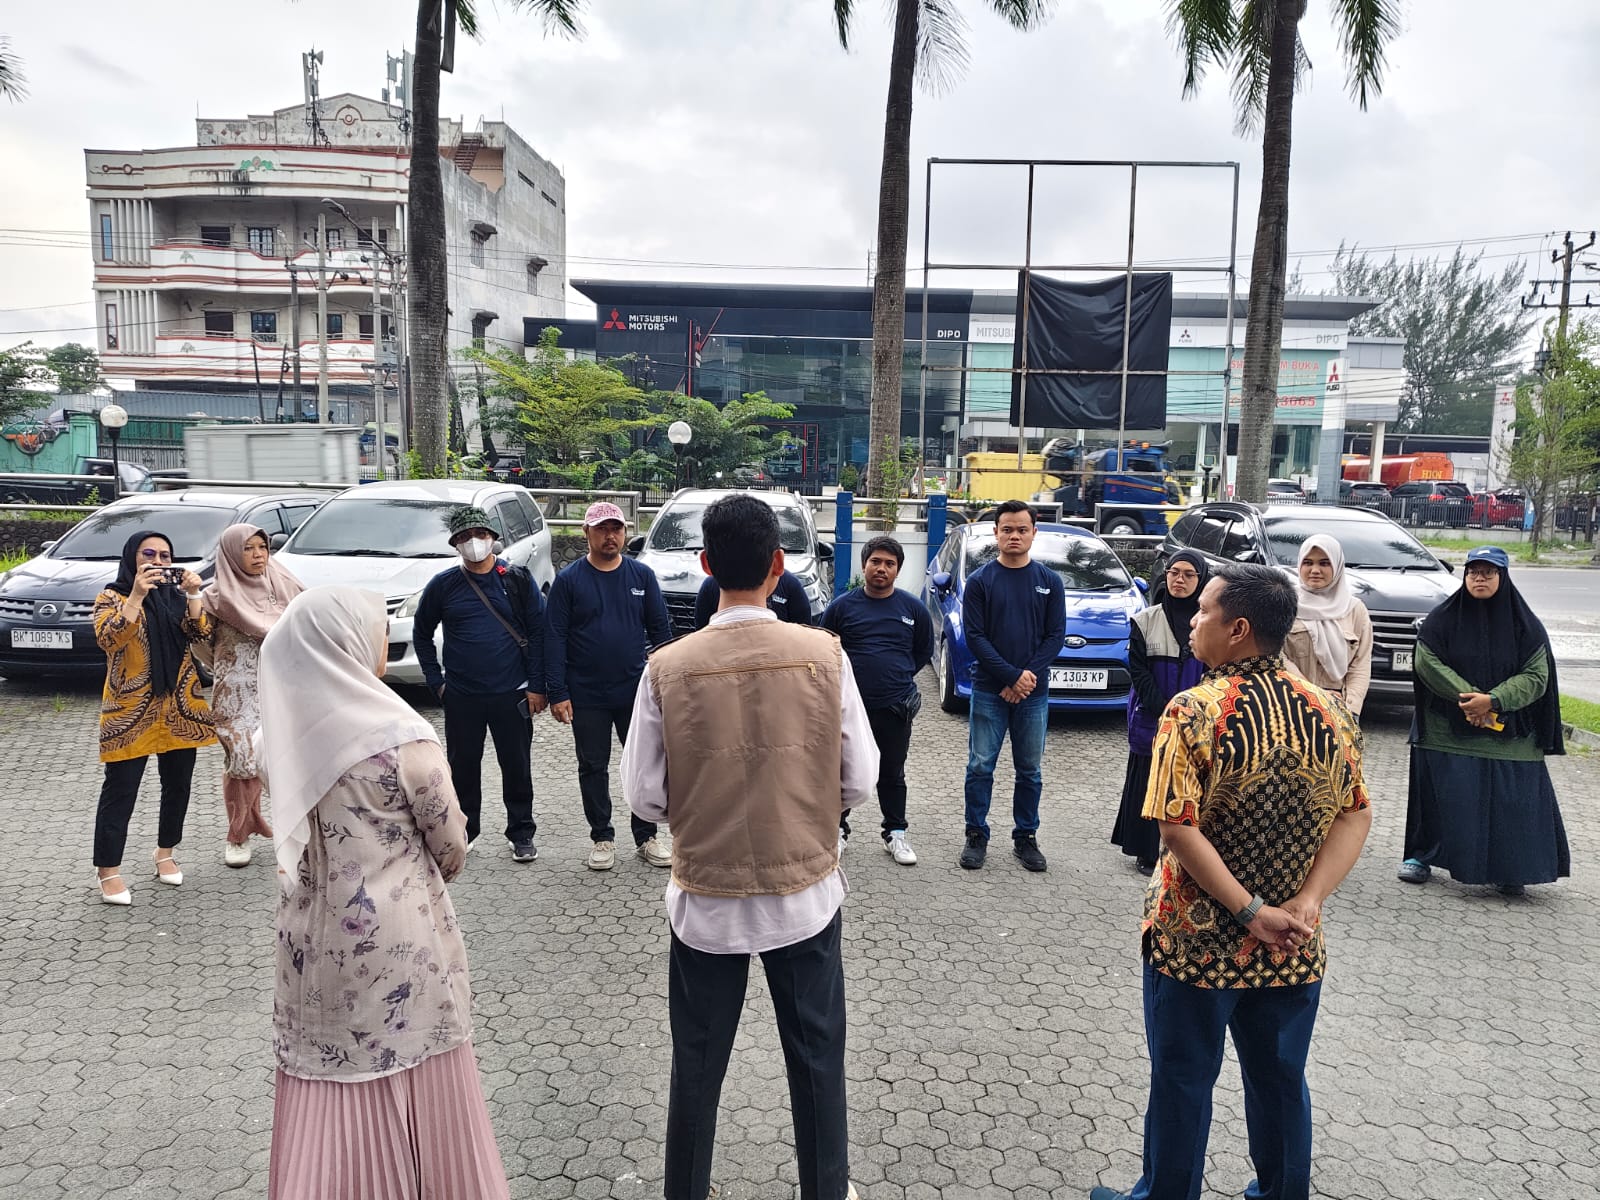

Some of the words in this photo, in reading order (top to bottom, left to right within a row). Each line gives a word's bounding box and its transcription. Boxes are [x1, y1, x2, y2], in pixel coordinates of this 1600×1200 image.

[629, 315, 678, 323] MITSUBISHI
[937, 330, 960, 338] DIPO
[977, 328, 1013, 337] MITSUBI
[1316, 334, 1340, 344] DIPO
[1291, 360, 1320, 371] BUKA
[13, 631, 25, 642] BK
[30, 631, 53, 643] 1089
[58, 632, 71, 644] KS
[1396, 654, 1408, 664] BK
[1063, 671, 1088, 682] 1303
[1091, 671, 1104, 683] KP
